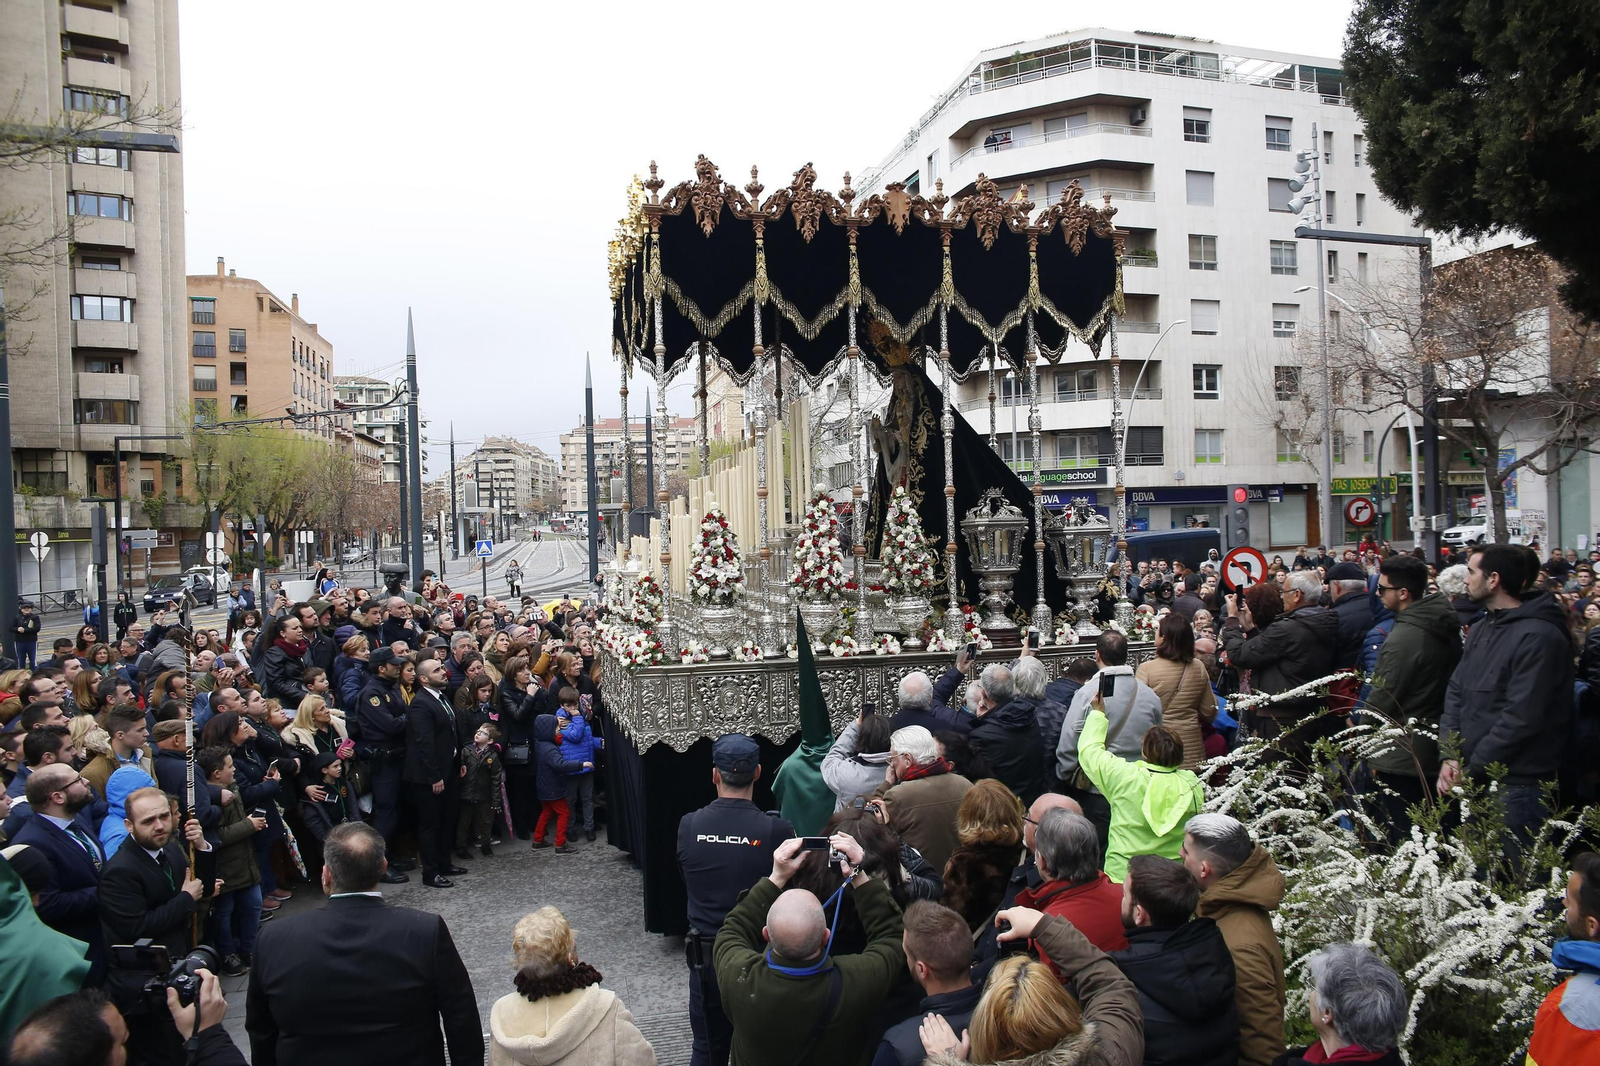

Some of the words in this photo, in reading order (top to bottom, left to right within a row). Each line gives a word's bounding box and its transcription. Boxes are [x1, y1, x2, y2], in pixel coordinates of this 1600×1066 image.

[1017, 470, 1097, 483] dalaguageschool
[1041, 494, 1060, 504] BVA
[1132, 492, 1155, 501] BBVA
[1249, 489, 1263, 499] BVA
[696, 834, 751, 845] POLICIA
